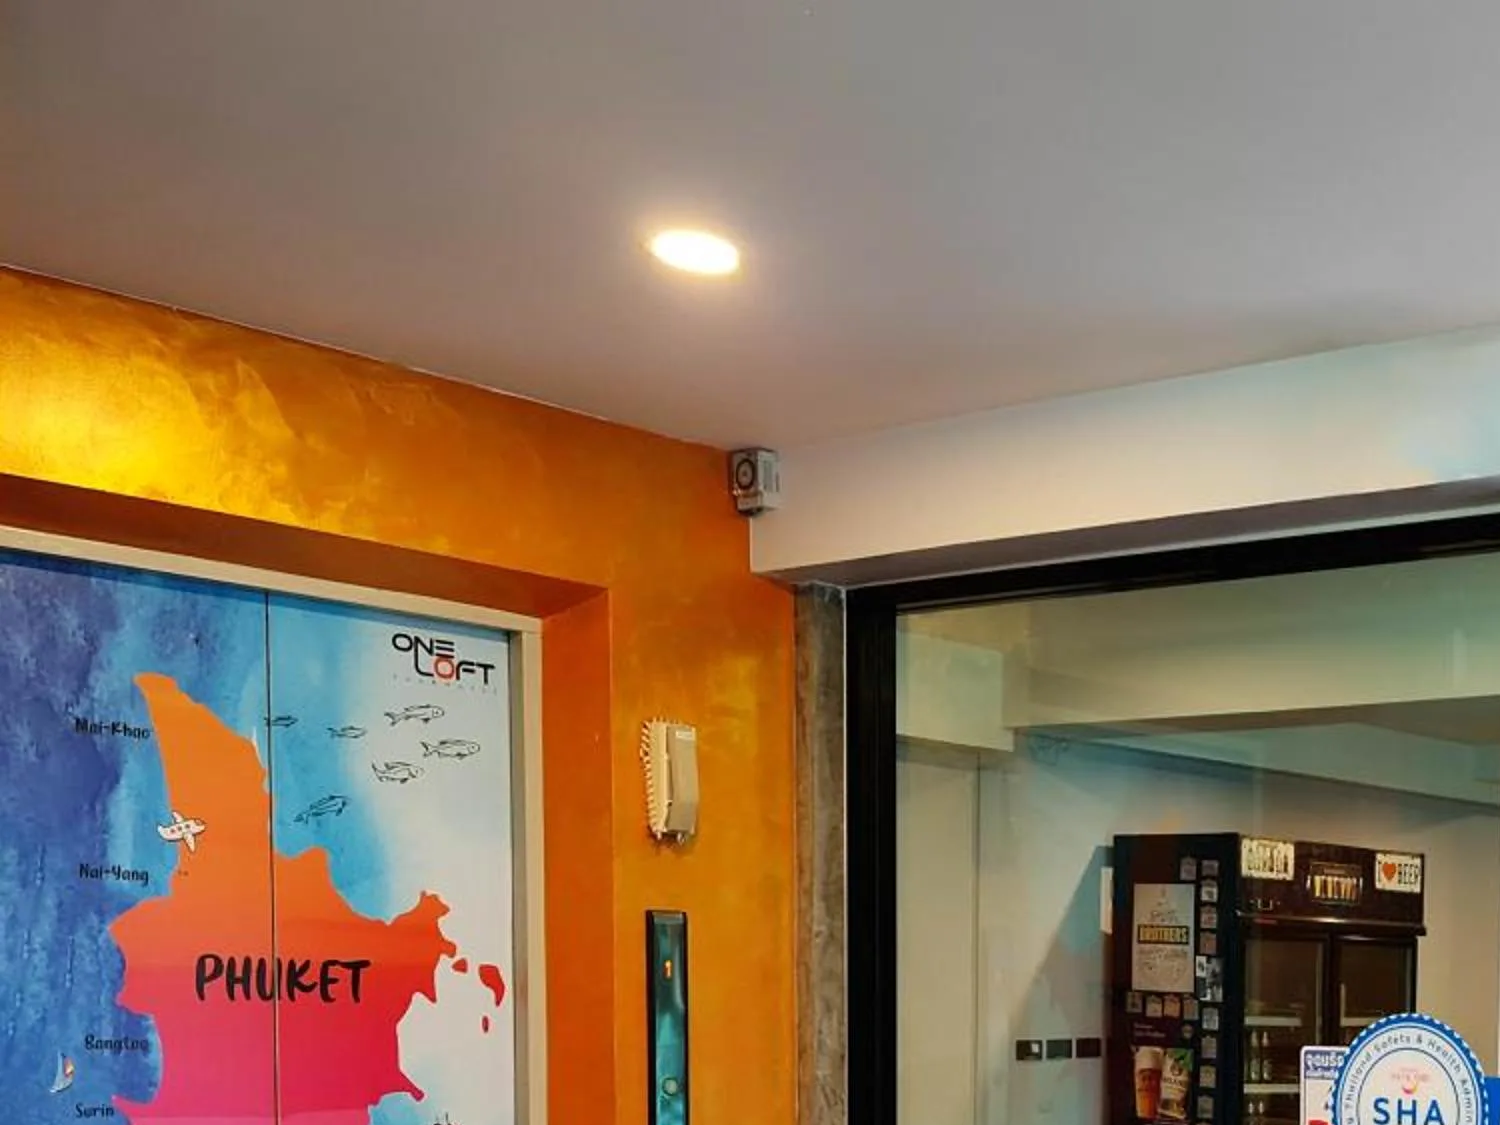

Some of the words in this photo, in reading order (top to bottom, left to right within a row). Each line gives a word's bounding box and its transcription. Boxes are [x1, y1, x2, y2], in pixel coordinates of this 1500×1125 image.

[392, 633, 454, 658] ONE
[414, 656, 496, 684] LOFT
[195, 953, 372, 1003] PHUKET
[75, 1103, 115, 1118] Surin
